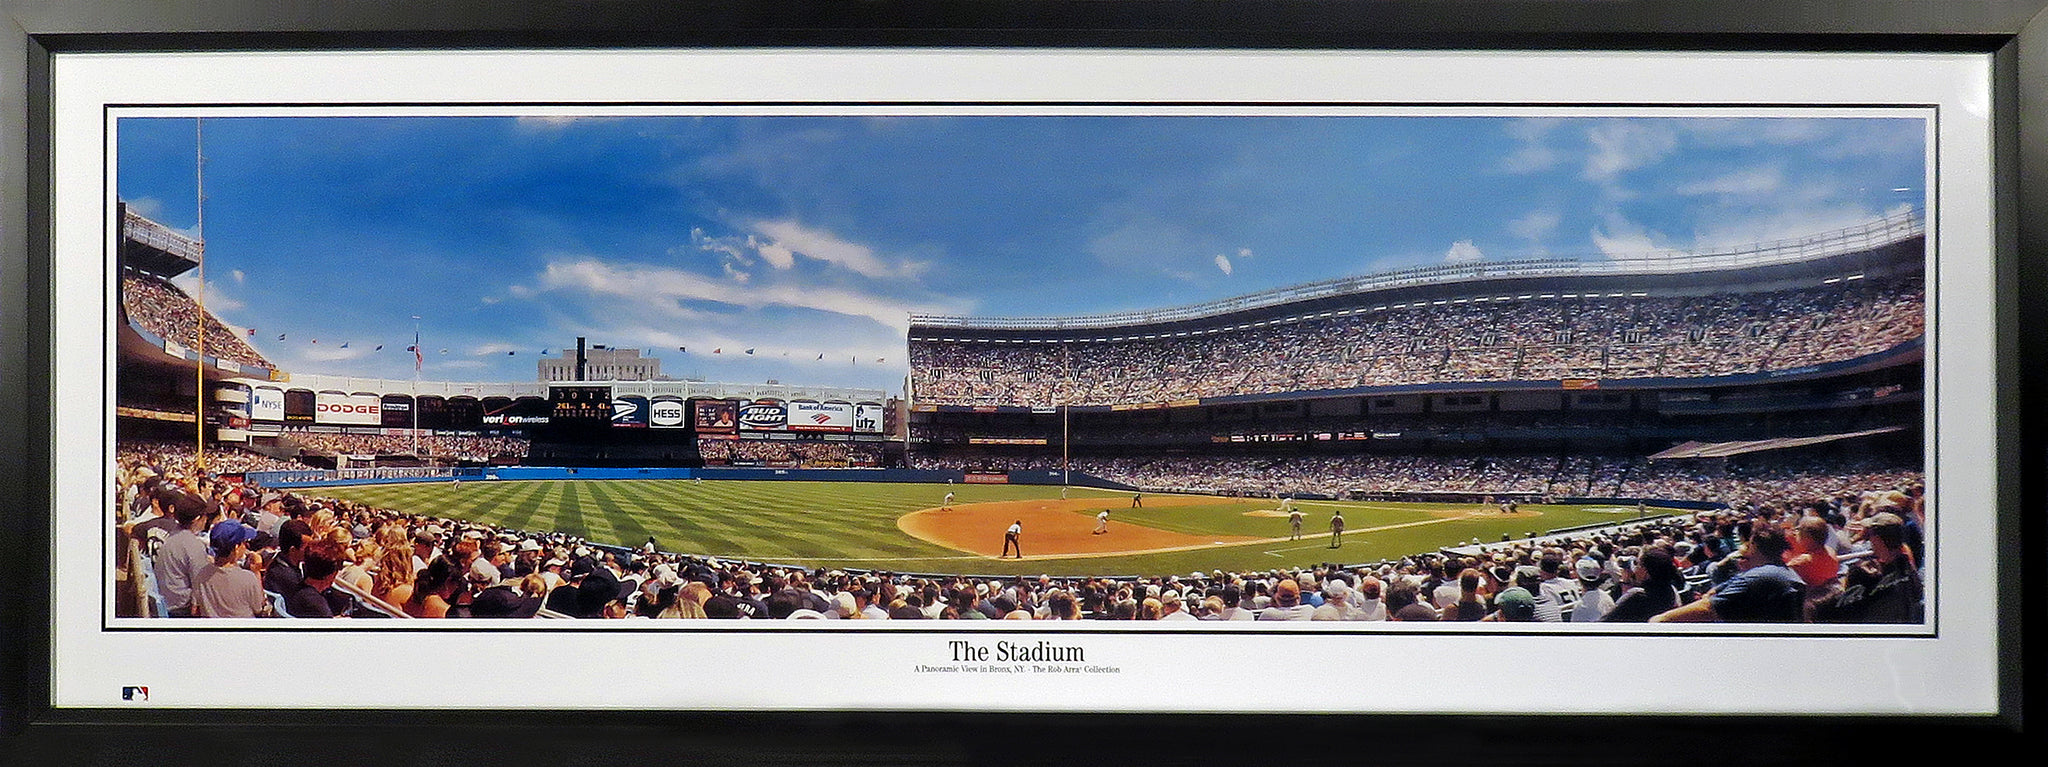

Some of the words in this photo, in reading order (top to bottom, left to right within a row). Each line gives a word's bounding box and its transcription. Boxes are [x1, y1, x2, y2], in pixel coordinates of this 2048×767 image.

[262, 400, 282, 410] NYSE
[317, 404, 379, 414] DODGE
[820, 404, 843, 412] America
[653, 409, 681, 419] HESS
[855, 418, 876, 429] utz
[948, 640, 989, 662] The
[996, 640, 1085, 662] Stadium
[913, 665, 920, 673] A
[921, 664, 959, 673] Panoramic
[961, 664, 979, 673] View
[980, 664, 988, 673] in
[989, 664, 1013, 674] Bronx,
[1032, 665, 1046, 673] The
[1047, 664, 1062, 673] Rob
[1083, 664, 1121, 673] Collection
